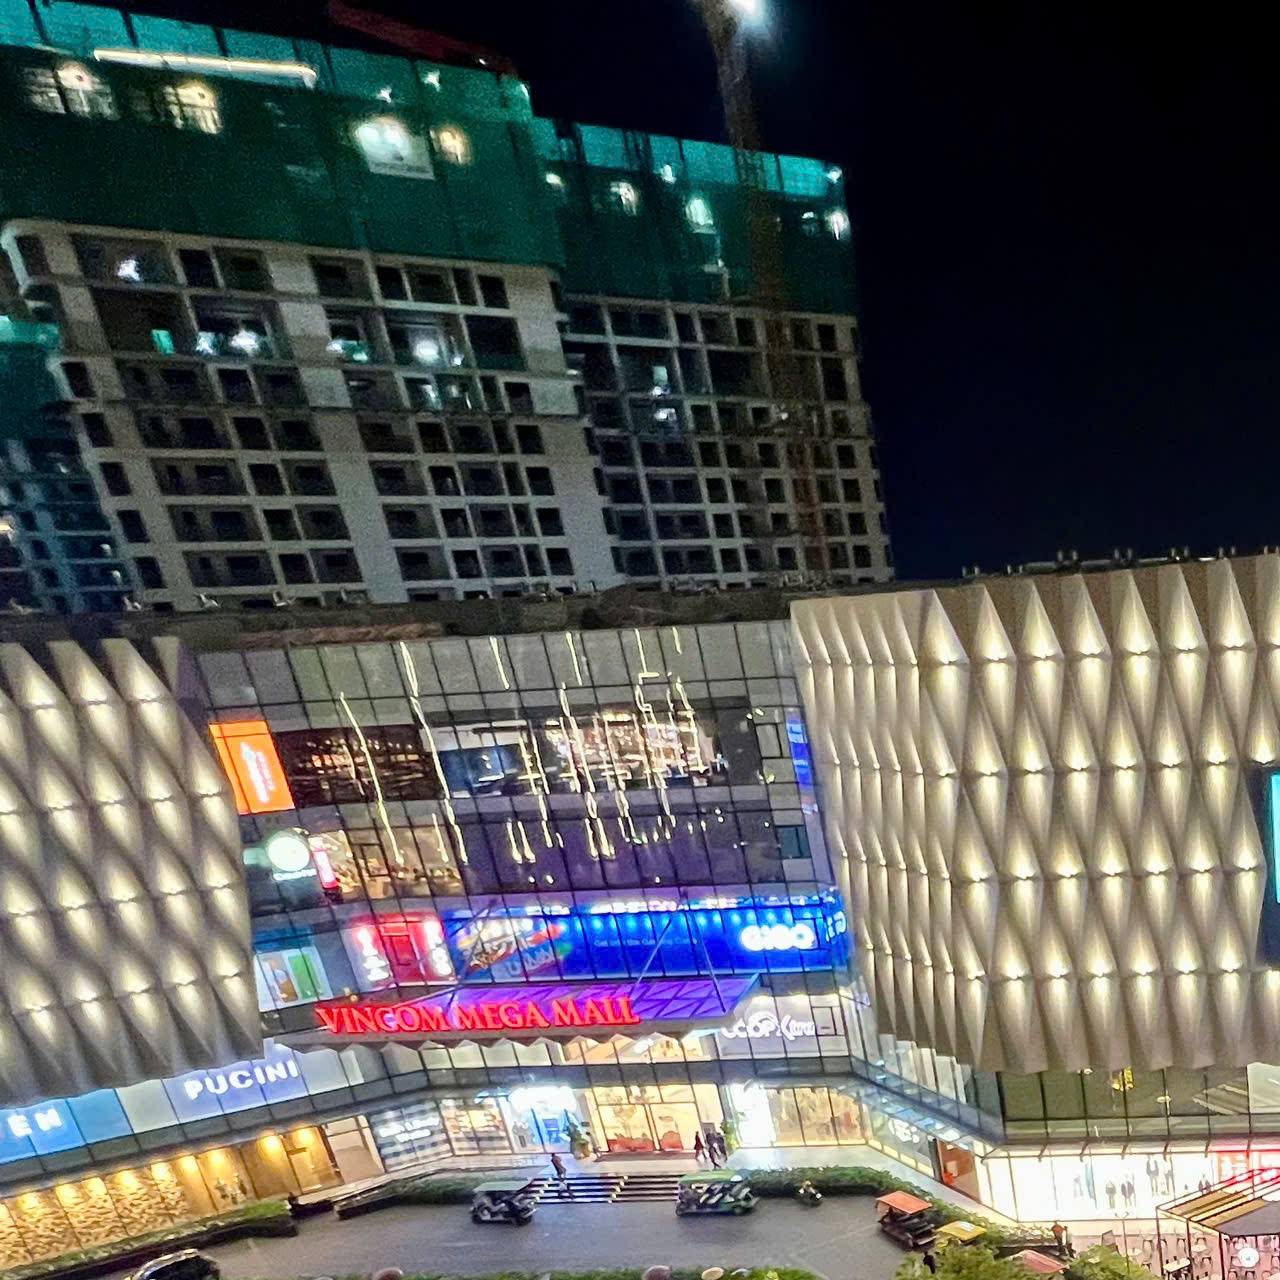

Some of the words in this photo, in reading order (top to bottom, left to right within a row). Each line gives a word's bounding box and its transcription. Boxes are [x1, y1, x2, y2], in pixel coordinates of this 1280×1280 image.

[314, 1004, 449, 1034] VINCOM
[454, 1000, 550, 1030] MEGA
[552, 995, 640, 1026] MALL
[184, 1060, 299, 1100] PUCINI
